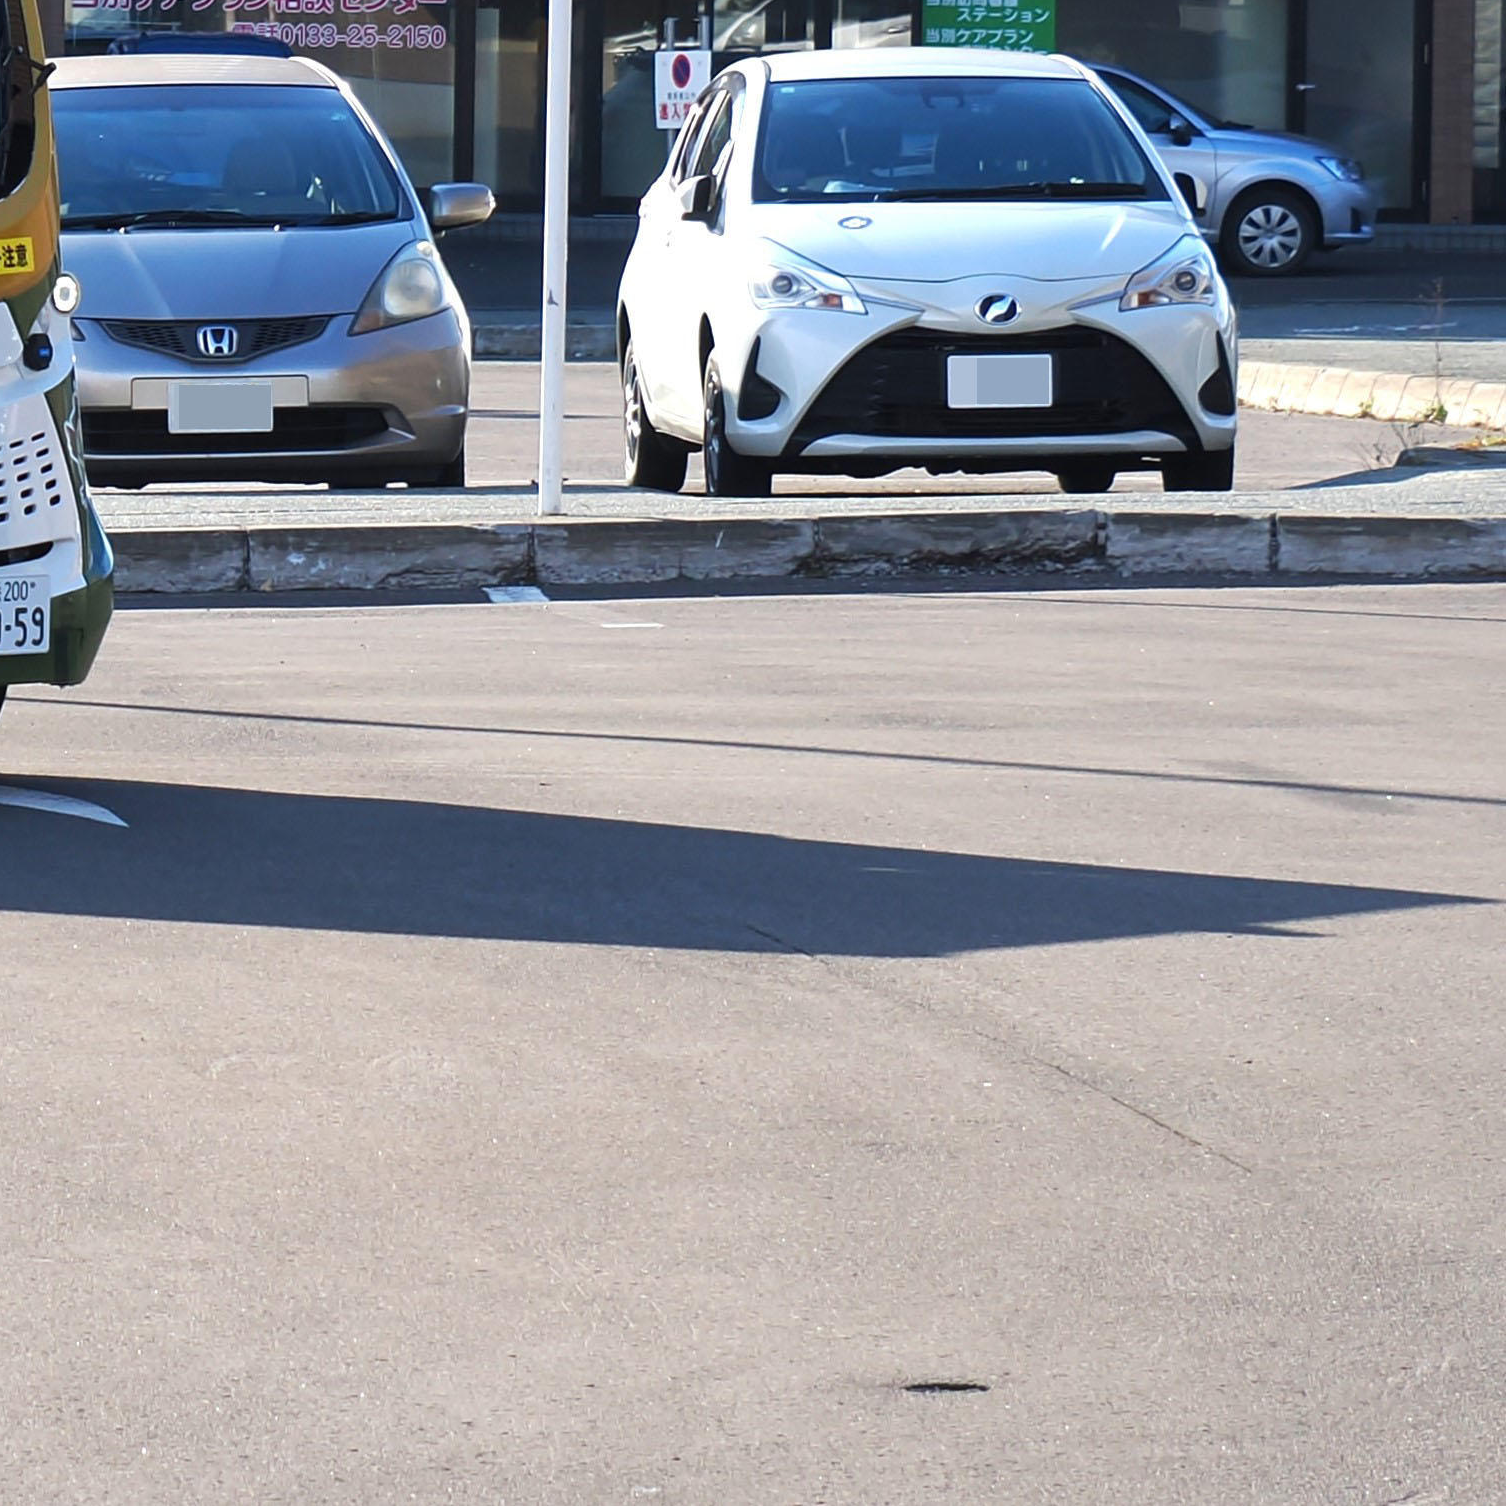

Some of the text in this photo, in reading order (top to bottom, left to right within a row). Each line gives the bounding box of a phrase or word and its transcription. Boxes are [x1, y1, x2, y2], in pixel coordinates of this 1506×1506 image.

[956, 7, 1050, 23] ステーション
[926, 28, 1034, 44] 当別ケアプラン
